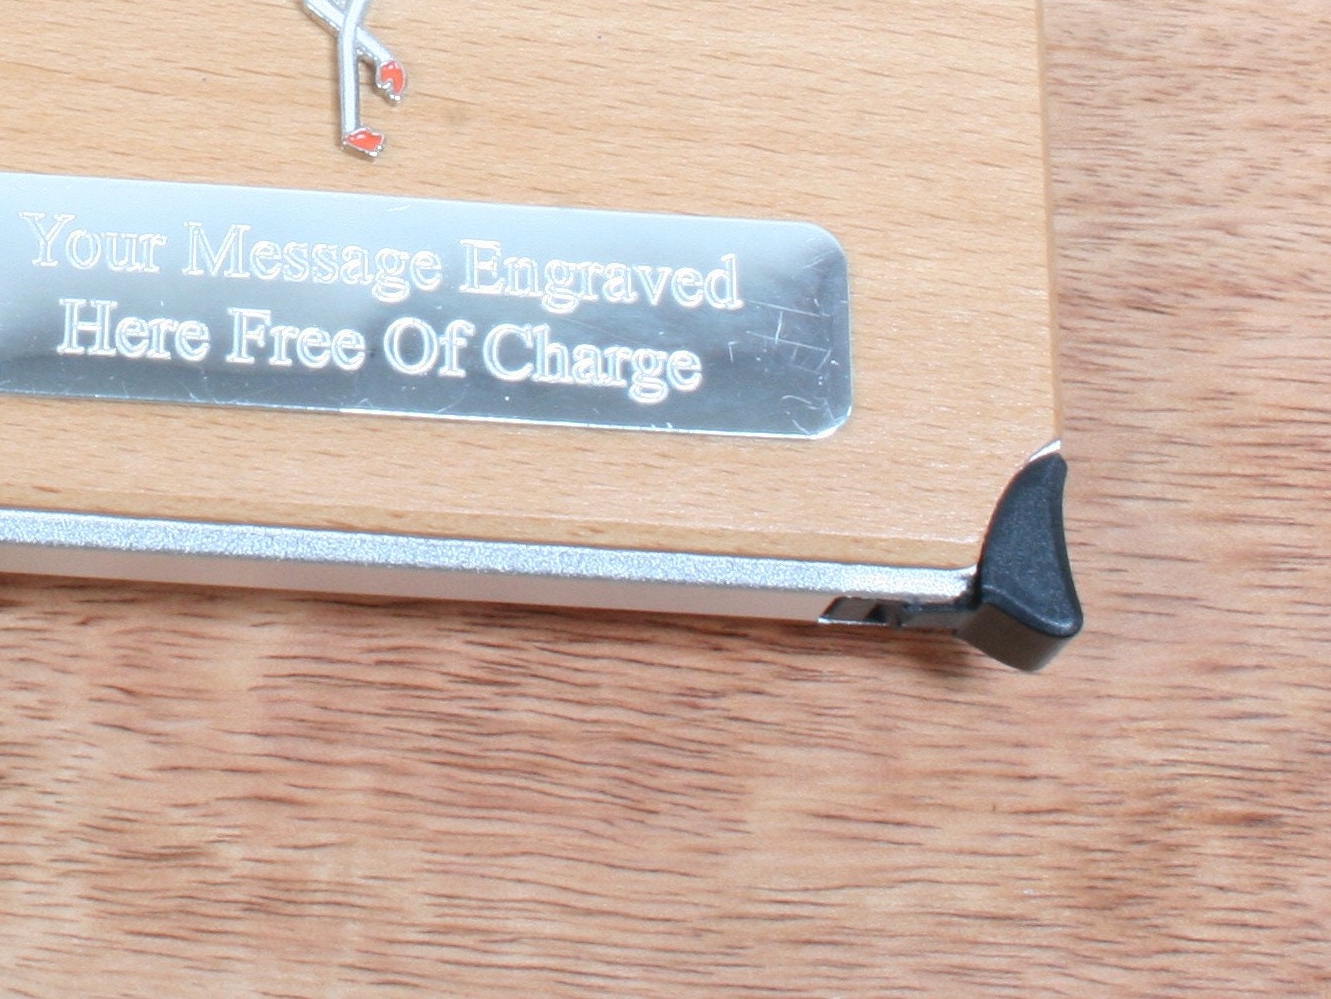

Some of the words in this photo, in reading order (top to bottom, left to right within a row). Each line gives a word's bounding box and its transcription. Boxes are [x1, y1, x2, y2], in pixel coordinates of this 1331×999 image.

[19, 210, 167, 276] Your
[183, 220, 443, 303] Message
[459, 236, 744, 313] Engraved
[56, 297, 210, 362] Here
[227, 306, 366, 372] Free
[386, 316, 475, 378] Of
[484, 322, 703, 404] Charge
